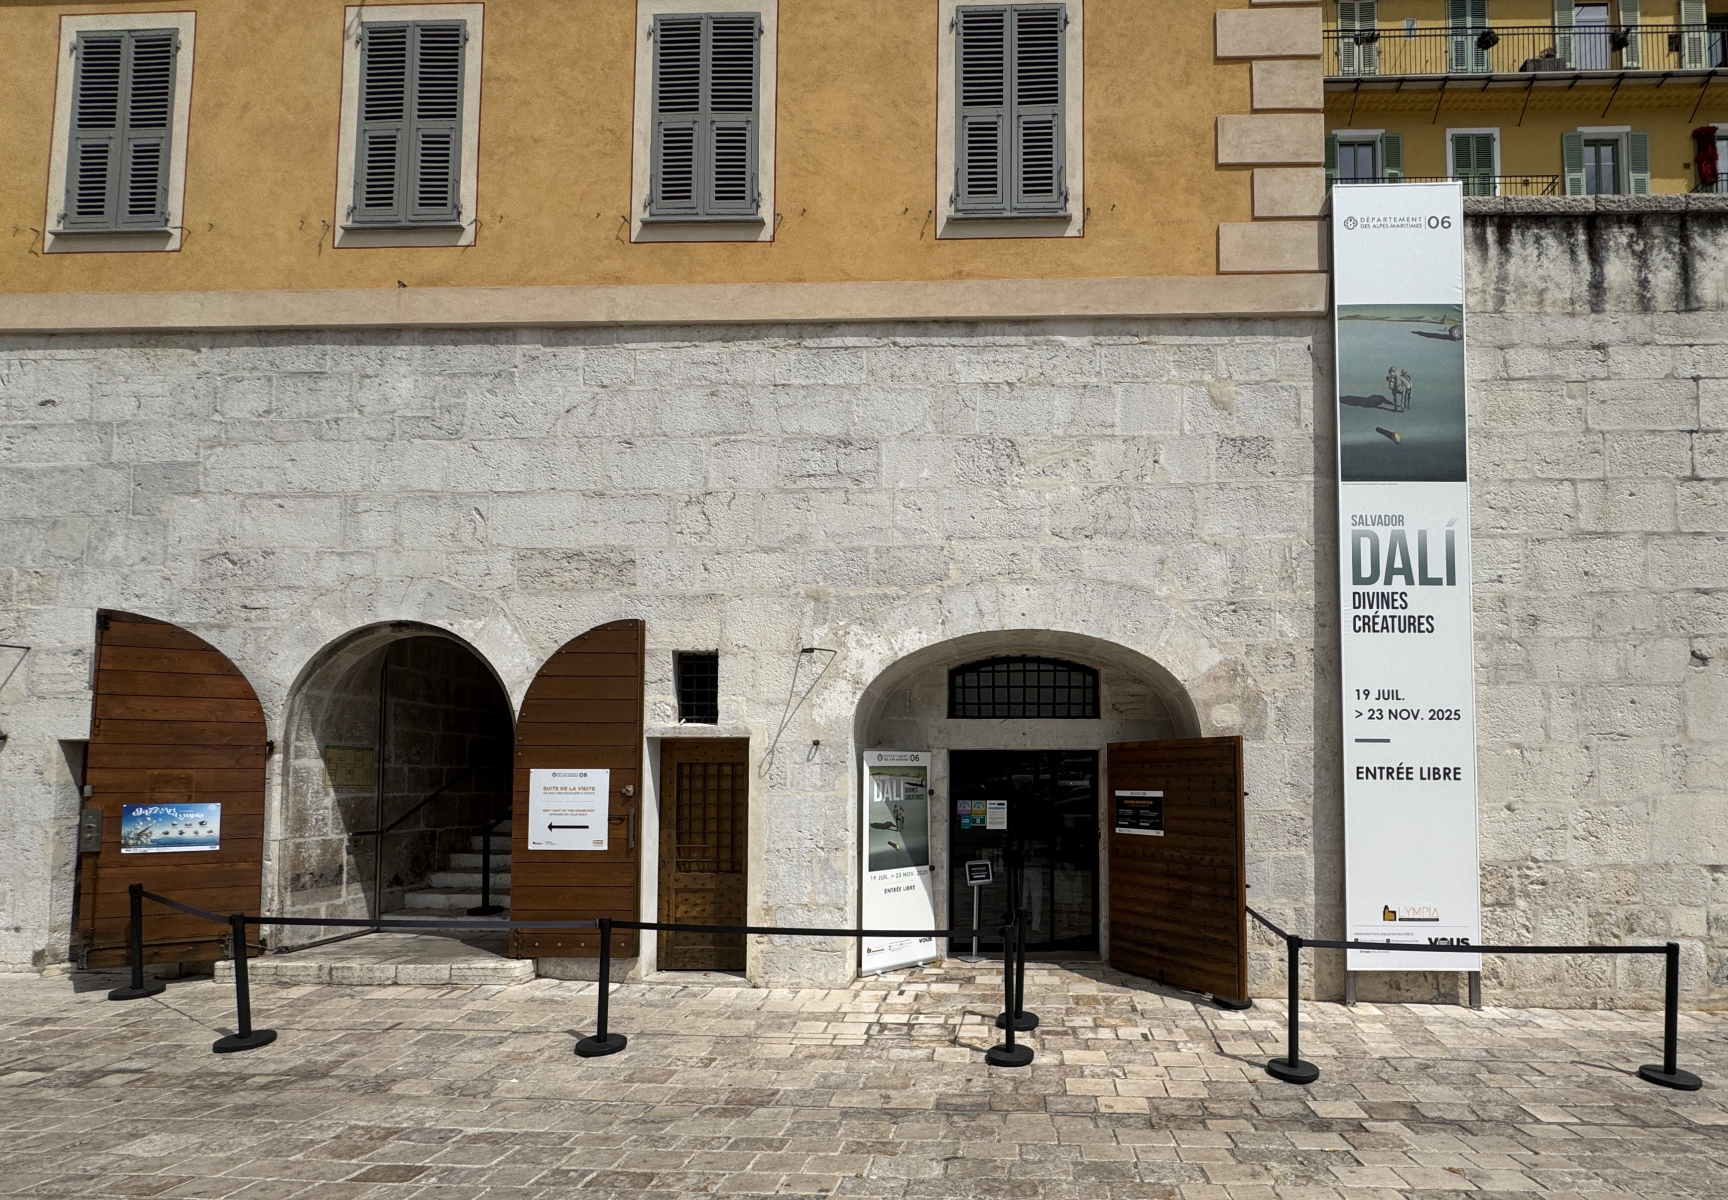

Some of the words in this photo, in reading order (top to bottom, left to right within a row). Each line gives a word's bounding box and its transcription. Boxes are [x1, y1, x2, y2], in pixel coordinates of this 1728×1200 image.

[1427, 215, 1452, 229] 06
[1351, 514, 1405, 527] SALVADOR
[1351, 517, 1459, 587] DALÍ
[1352, 591, 1408, 610] DIVINES
[1352, 611, 1435, 633] CRÉATURES
[1355, 689, 1371, 701] 19
[1375, 689, 1405, 701] JUIL.
[1367, 708, 1384, 721] 23
[1388, 708, 1424, 721] NOV.
[1428, 708, 1461, 721] 2025
[1356, 763, 1414, 781] ENTRÉE
[1419, 766, 1462, 781] LIBRE
[884, 885, 902, 894] ENTRÉE
[902, 884, 916, 892] LIBRE
[1398, 906, 1440, 917] LYMPIA
